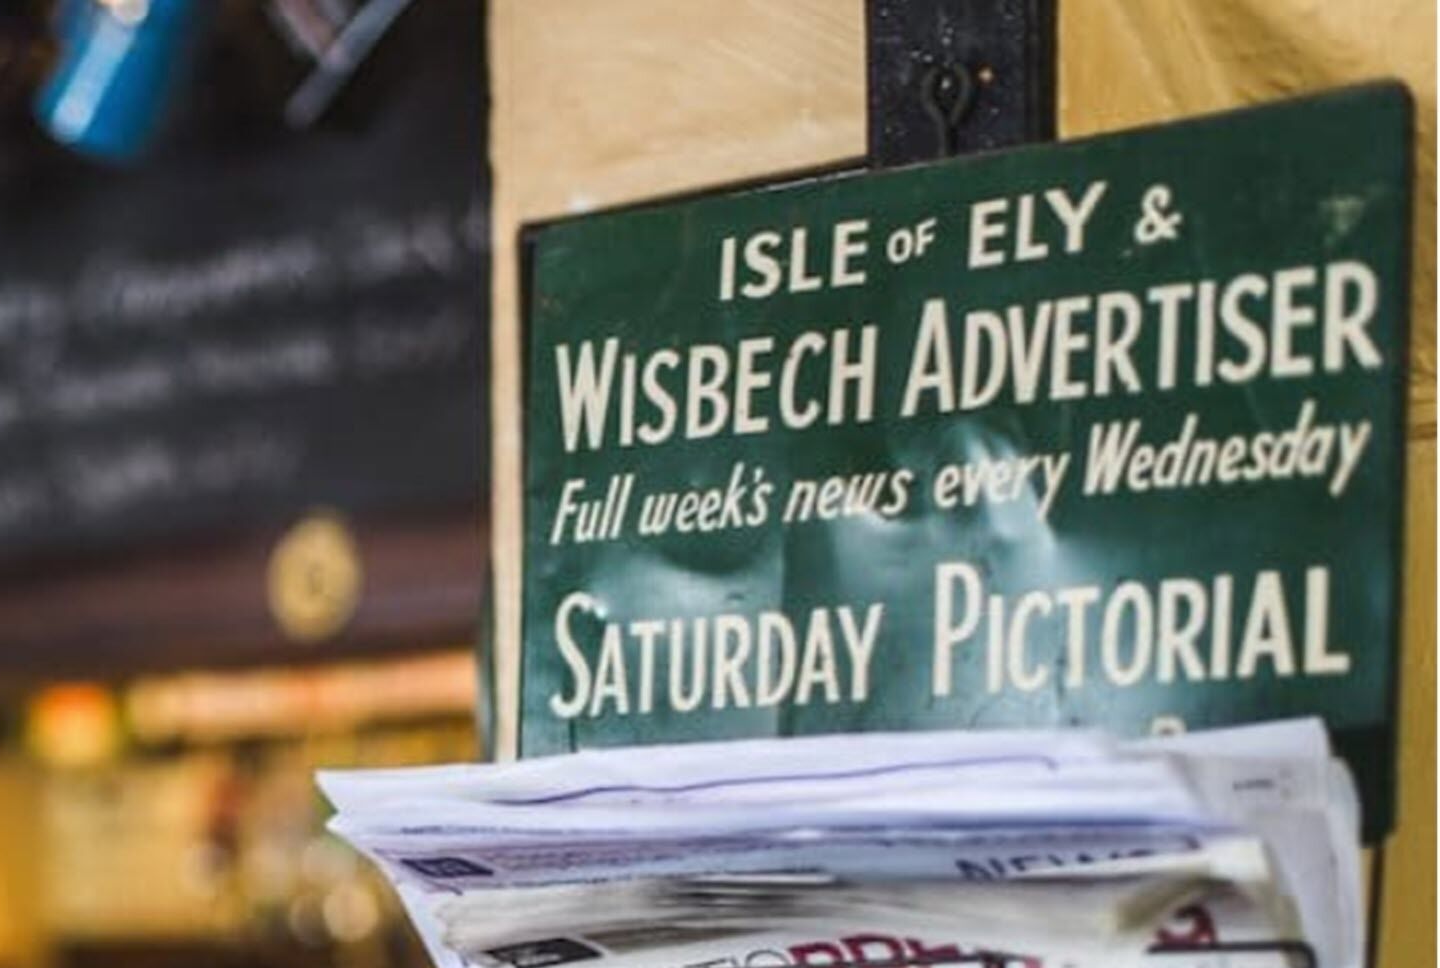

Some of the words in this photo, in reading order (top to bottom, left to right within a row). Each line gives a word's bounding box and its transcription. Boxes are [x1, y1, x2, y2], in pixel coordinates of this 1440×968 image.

[719, 219, 868, 301] ISLE
[886, 218, 937, 265] OF
[968, 181, 1107, 268] ELY
[1135, 186, 1182, 244] &
[556, 325, 878, 453] WISBECH
[901, 261, 1383, 417] ADVERTISER
[550, 473, 633, 546] Full
[638, 462, 775, 535] week's
[782, 467, 911, 524] news
[933, 448, 1070, 526] every
[1083, 401, 1372, 497] Wednesday
[549, 591, 885, 719] SATURDAY
[931, 560, 1351, 699] PICTORIAL
